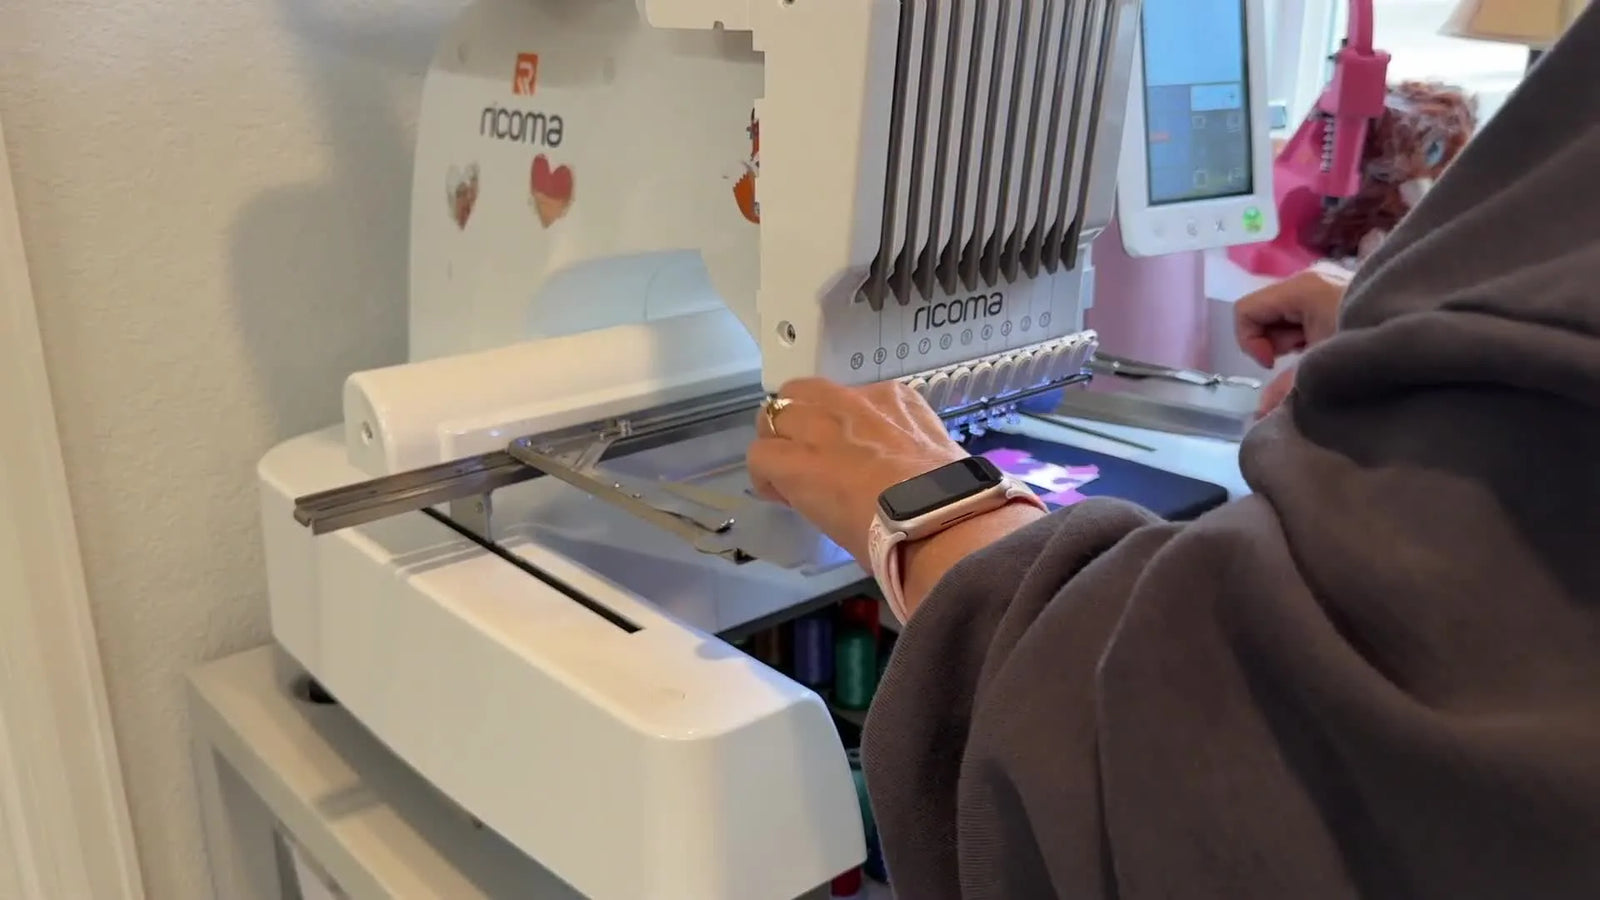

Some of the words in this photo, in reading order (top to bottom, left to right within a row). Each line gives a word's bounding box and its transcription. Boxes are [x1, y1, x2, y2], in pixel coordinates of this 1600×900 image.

[480, 102, 563, 148] ricoma
[913, 292, 1003, 332] ricoma
[852, 354, 863, 367] 10
